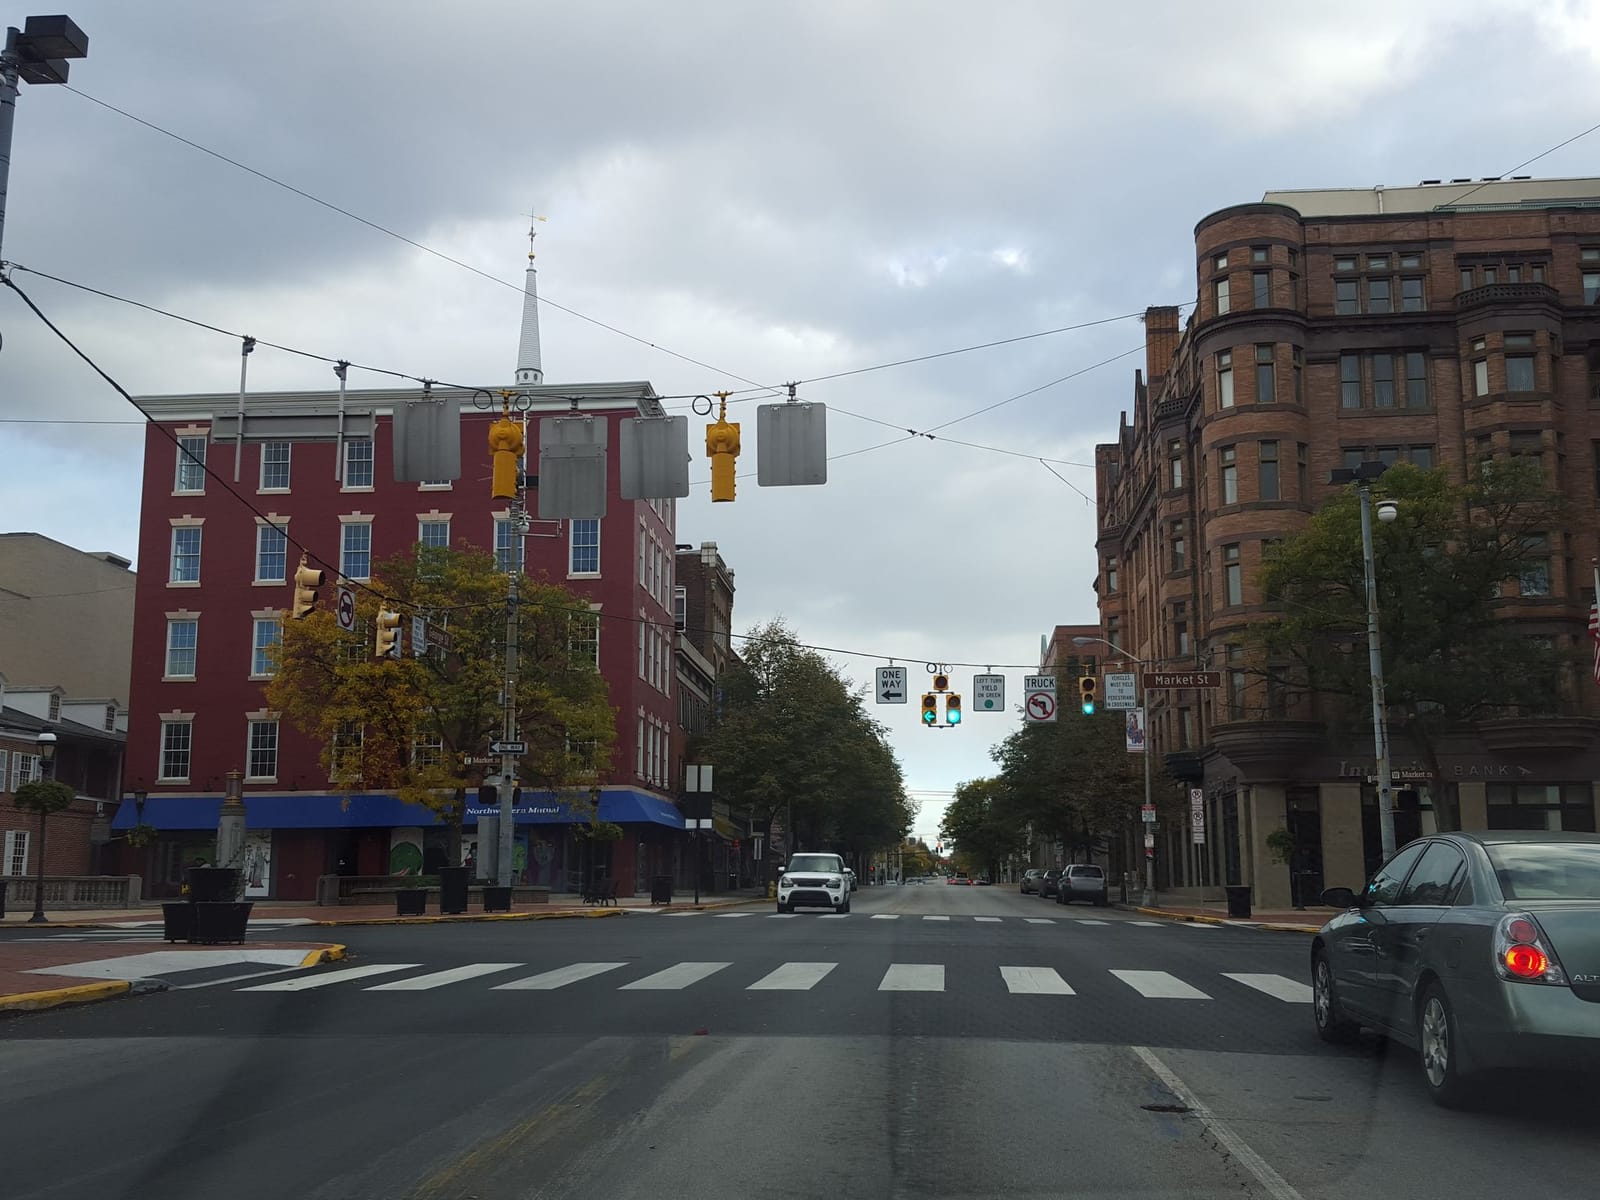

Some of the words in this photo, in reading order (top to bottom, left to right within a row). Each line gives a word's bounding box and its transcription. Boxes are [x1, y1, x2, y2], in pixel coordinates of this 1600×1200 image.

[882, 671, 901, 679] ONE
[1155, 675, 1193, 685] Market
[1197, 674, 1209, 684] St
[881, 680, 902, 688] WAY
[1026, 678, 1055, 688] TRUCK
[1455, 765, 1509, 776] BANK
[466, 807, 527, 815] Northwern
[528, 806, 560, 814] Mutual
